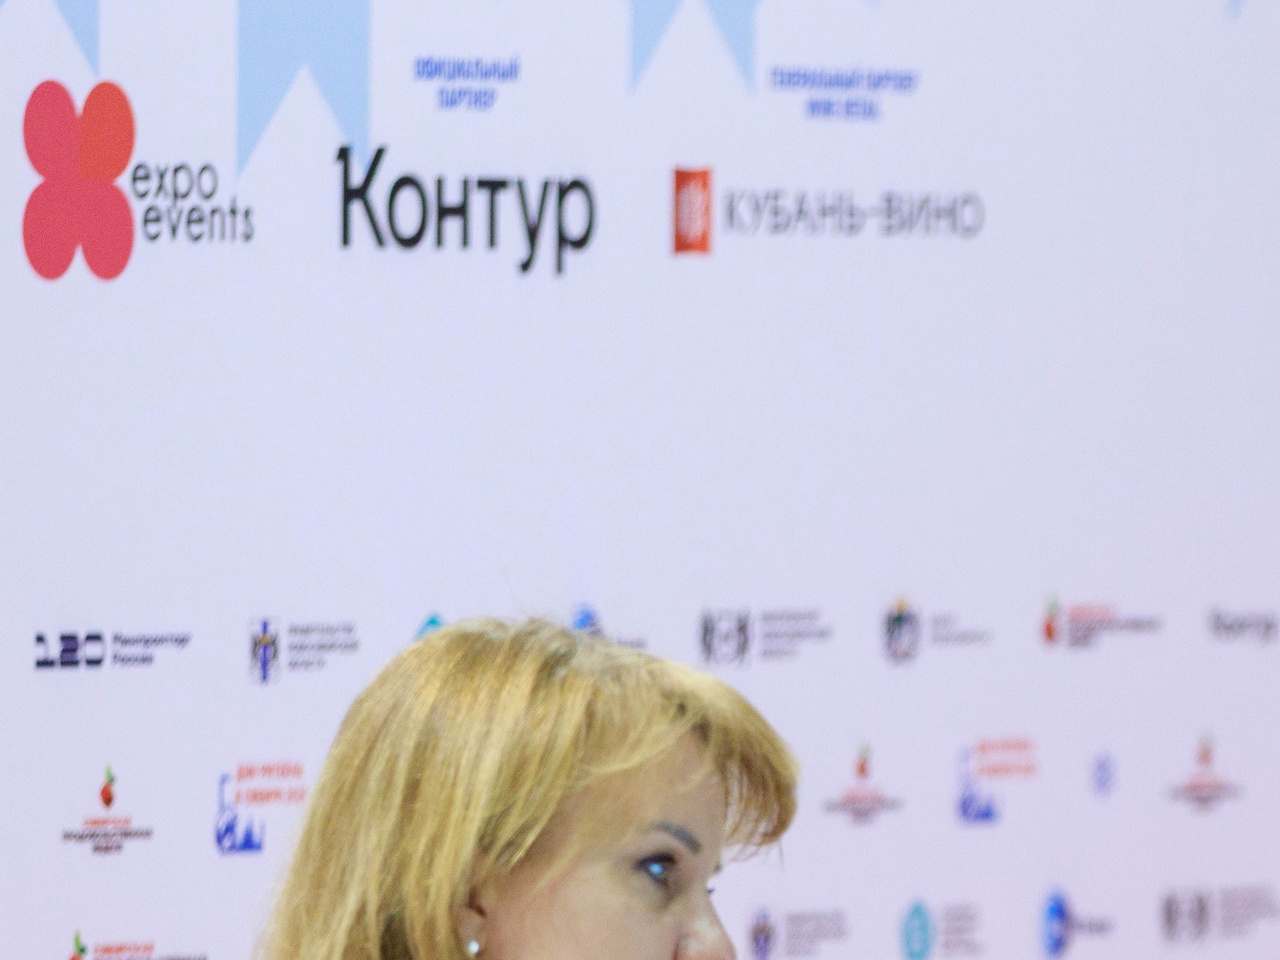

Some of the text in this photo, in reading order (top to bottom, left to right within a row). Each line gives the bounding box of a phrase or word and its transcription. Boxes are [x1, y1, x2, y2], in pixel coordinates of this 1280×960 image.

[131, 162, 218, 207] expo
[143, 198, 254, 242] events
[335, 145, 596, 276] Контур
[722, 189, 987, 239] КУБАНЬ-ВИНО
